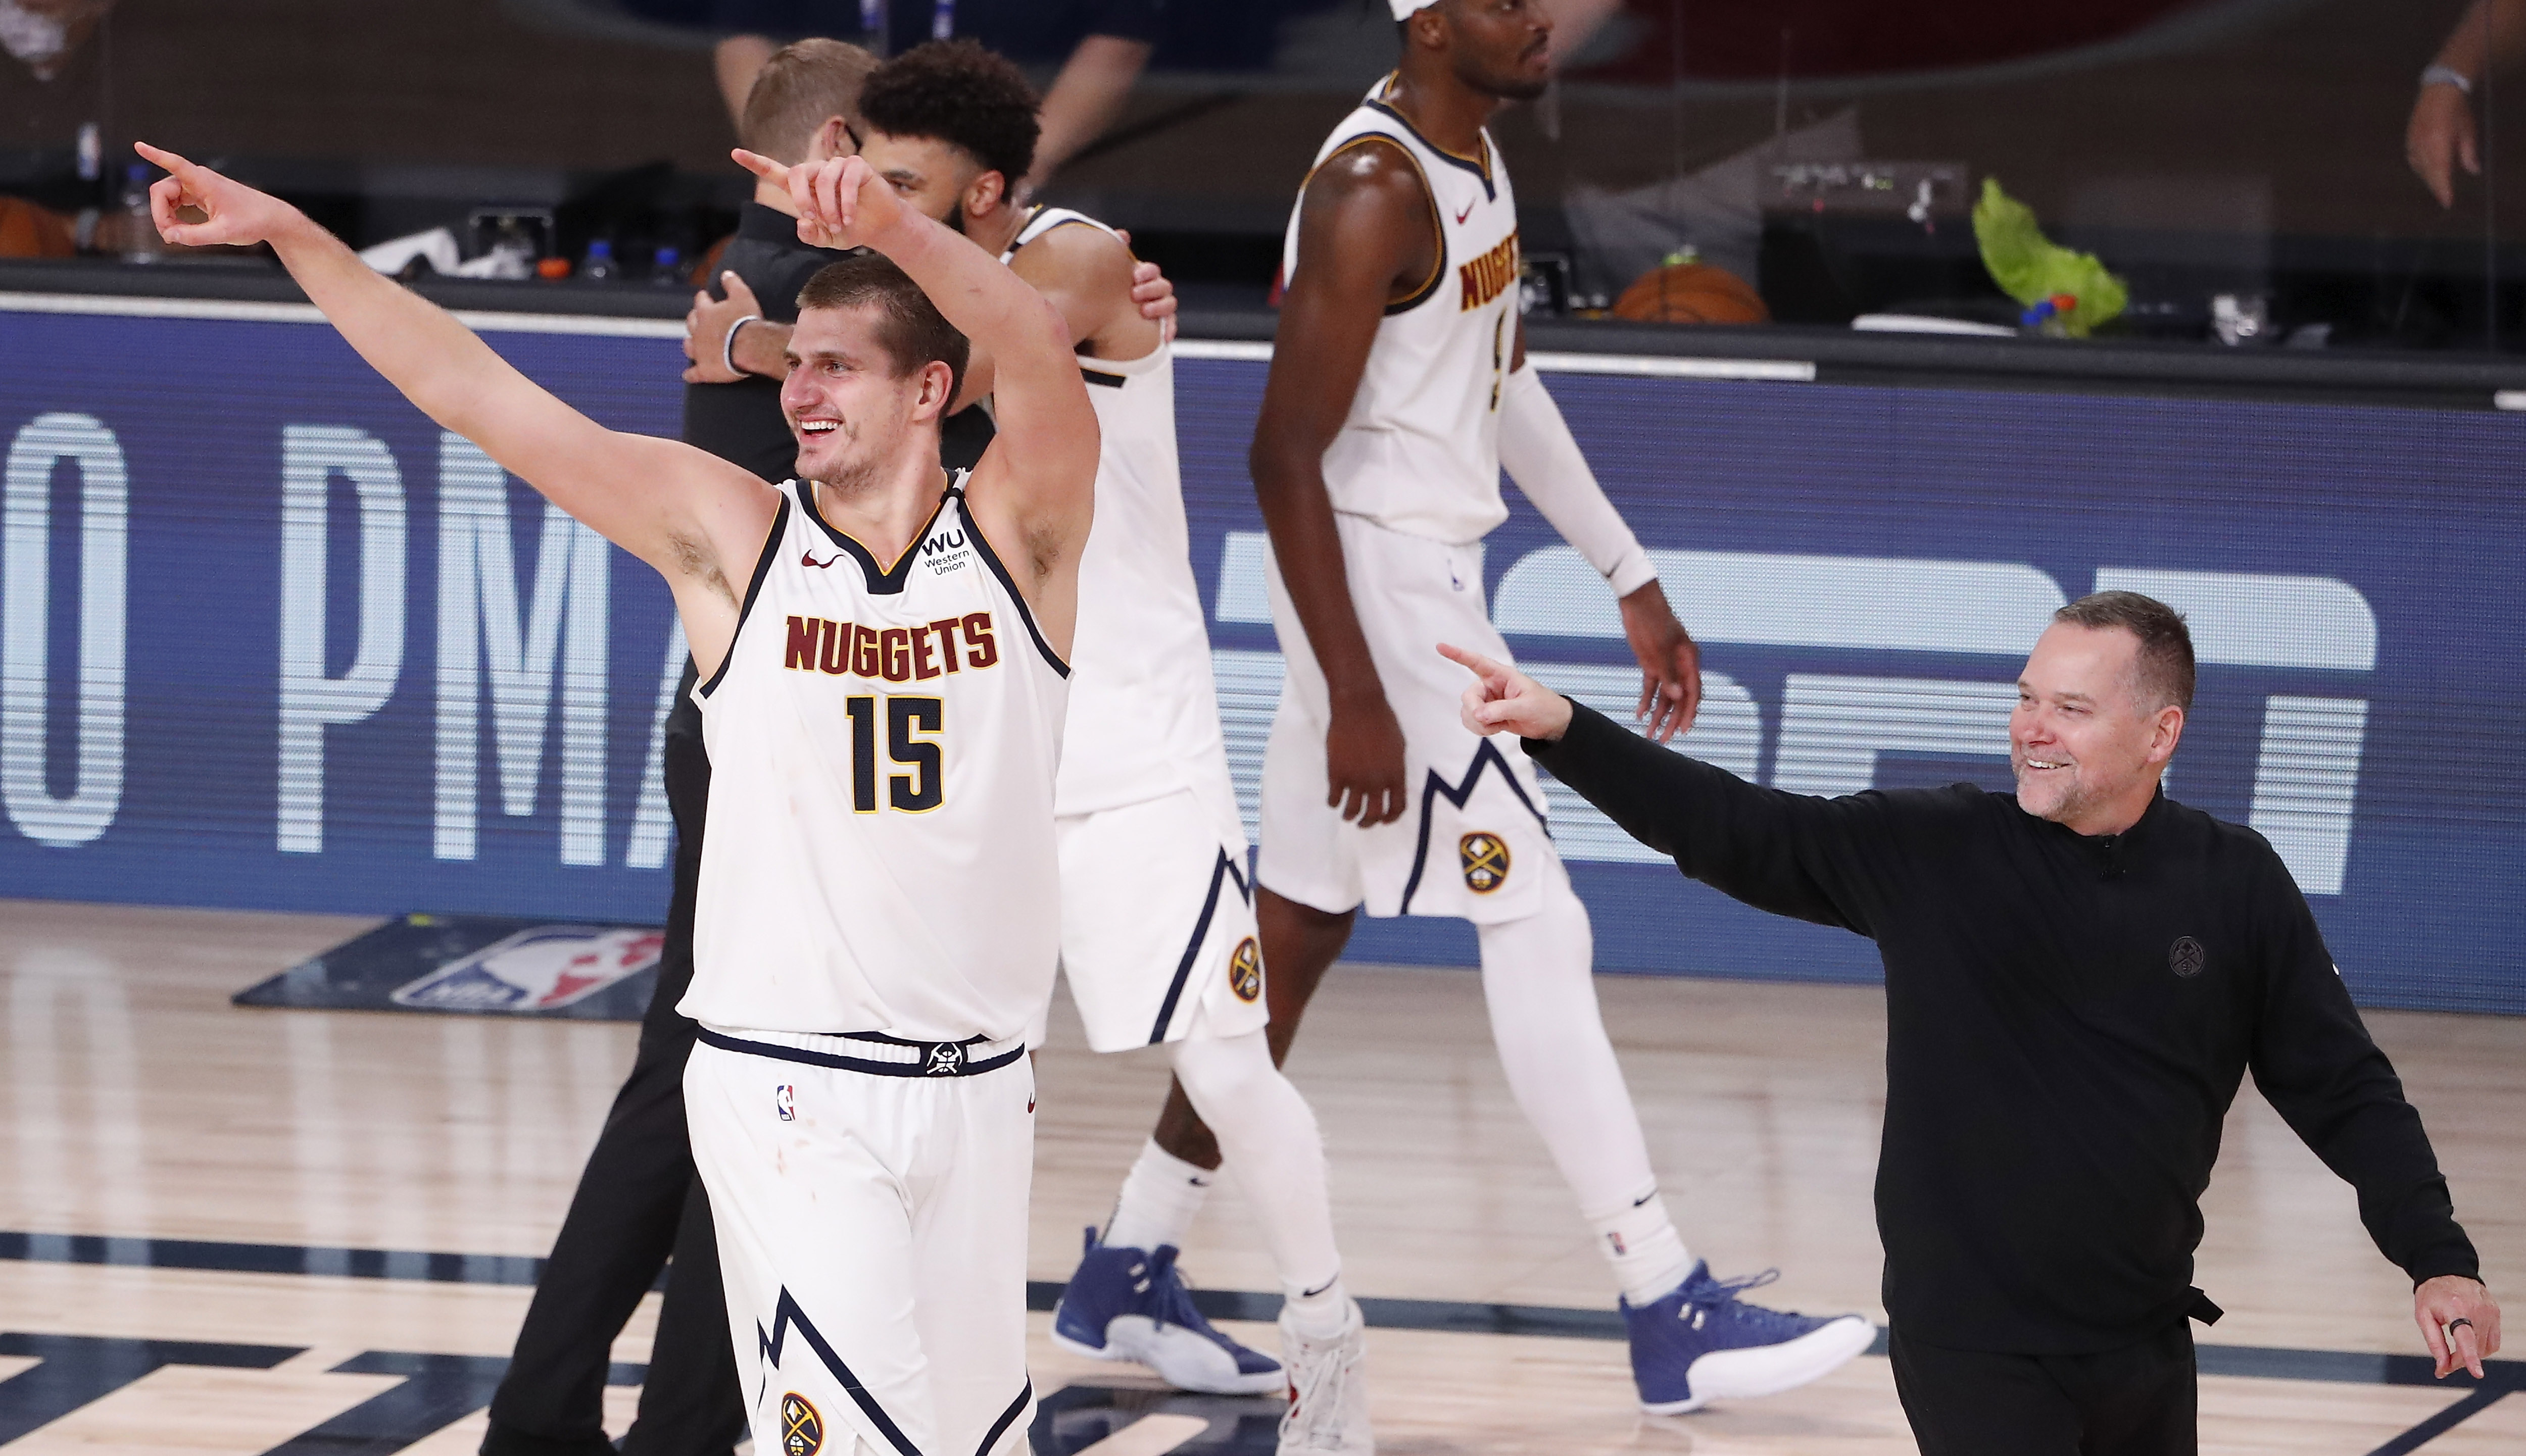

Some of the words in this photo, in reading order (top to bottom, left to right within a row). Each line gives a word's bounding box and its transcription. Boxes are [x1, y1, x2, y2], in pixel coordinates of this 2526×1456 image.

[922, 529, 964, 556] WU
[925, 550, 969, 568] Western
[935, 562, 965, 575] Union
[784, 611, 1000, 683] NUGGETS
[1212, 531, 2377, 895] SPN
[845, 694, 945, 815] 15
